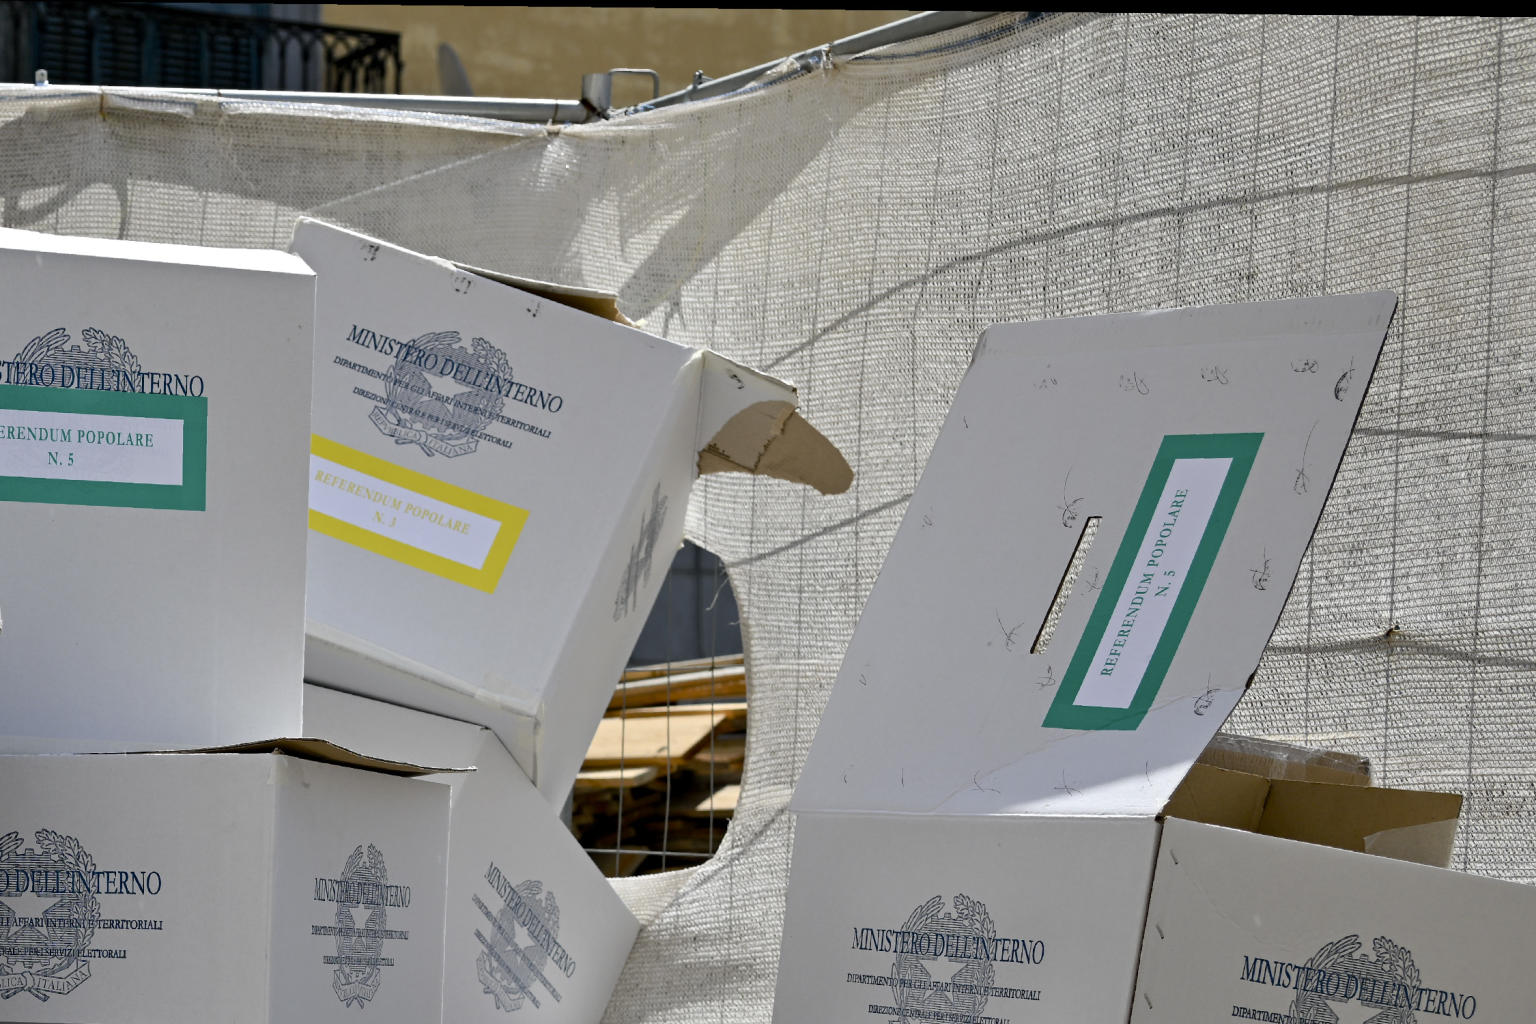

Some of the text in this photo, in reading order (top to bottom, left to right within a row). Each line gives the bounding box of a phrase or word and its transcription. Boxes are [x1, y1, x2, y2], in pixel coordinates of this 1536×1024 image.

[60, 364, 205, 398] DELL'INTERNO
[345, 324, 564, 414] MINISTERO DELL'INTERNO
[333, 355, 395, 383] DIPARTIMENTO
[495, 412, 551, 439] TERRITORIALI
[77, 429, 154, 448] POPOLARE
[48, 451, 75, 466] N. 5
[314, 469, 471, 536] REFERENDUM POPOLARE
[372, 511, 385, 525] N.
[1100, 488, 1188, 677] REFERENDUM POPOLARE
[1155, 580, 1172, 597] N.
[15, 869, 162, 895] DELL'INTERNO
[13, 917, 44, 929] AFFARI
[44, 917, 87, 929] INTERNI
[96, 919, 163, 930] TERRITORIALI
[78, 949, 127, 959] ELETTORALI
[851, 927, 1045, 965] MINISTERO DELL'INTERNO
[846, 973, 899, 987] DIPARTIMENTO
[990, 986, 1042, 1001] TERRITORIALI
[1240, 955, 1477, 1020] MINISTERO DELL'INTERNO
